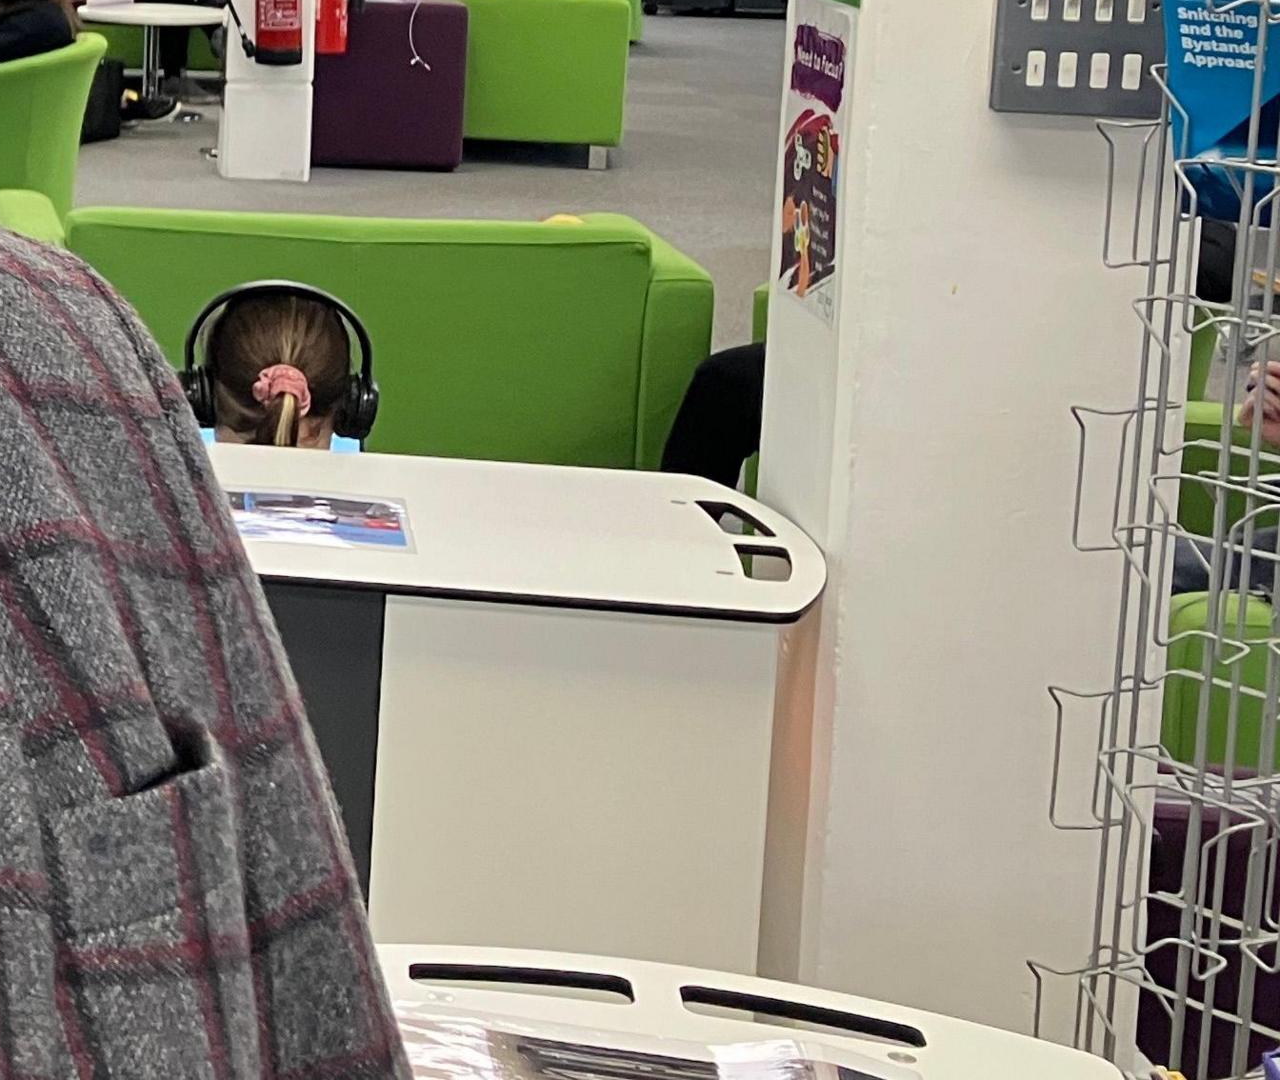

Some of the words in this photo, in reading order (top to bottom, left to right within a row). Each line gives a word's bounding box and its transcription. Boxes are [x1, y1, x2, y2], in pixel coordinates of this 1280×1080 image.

[1177, 6, 1258, 28] Snitching
[1180, 23, 1211, 37] and
[1214, 24, 1244, 39] the
[1181, 36, 1268, 55] Bystande
[797, 44, 813, 69] Need
[813, 52, 821, 71] to
[1183, 51, 1266, 70] Approac
